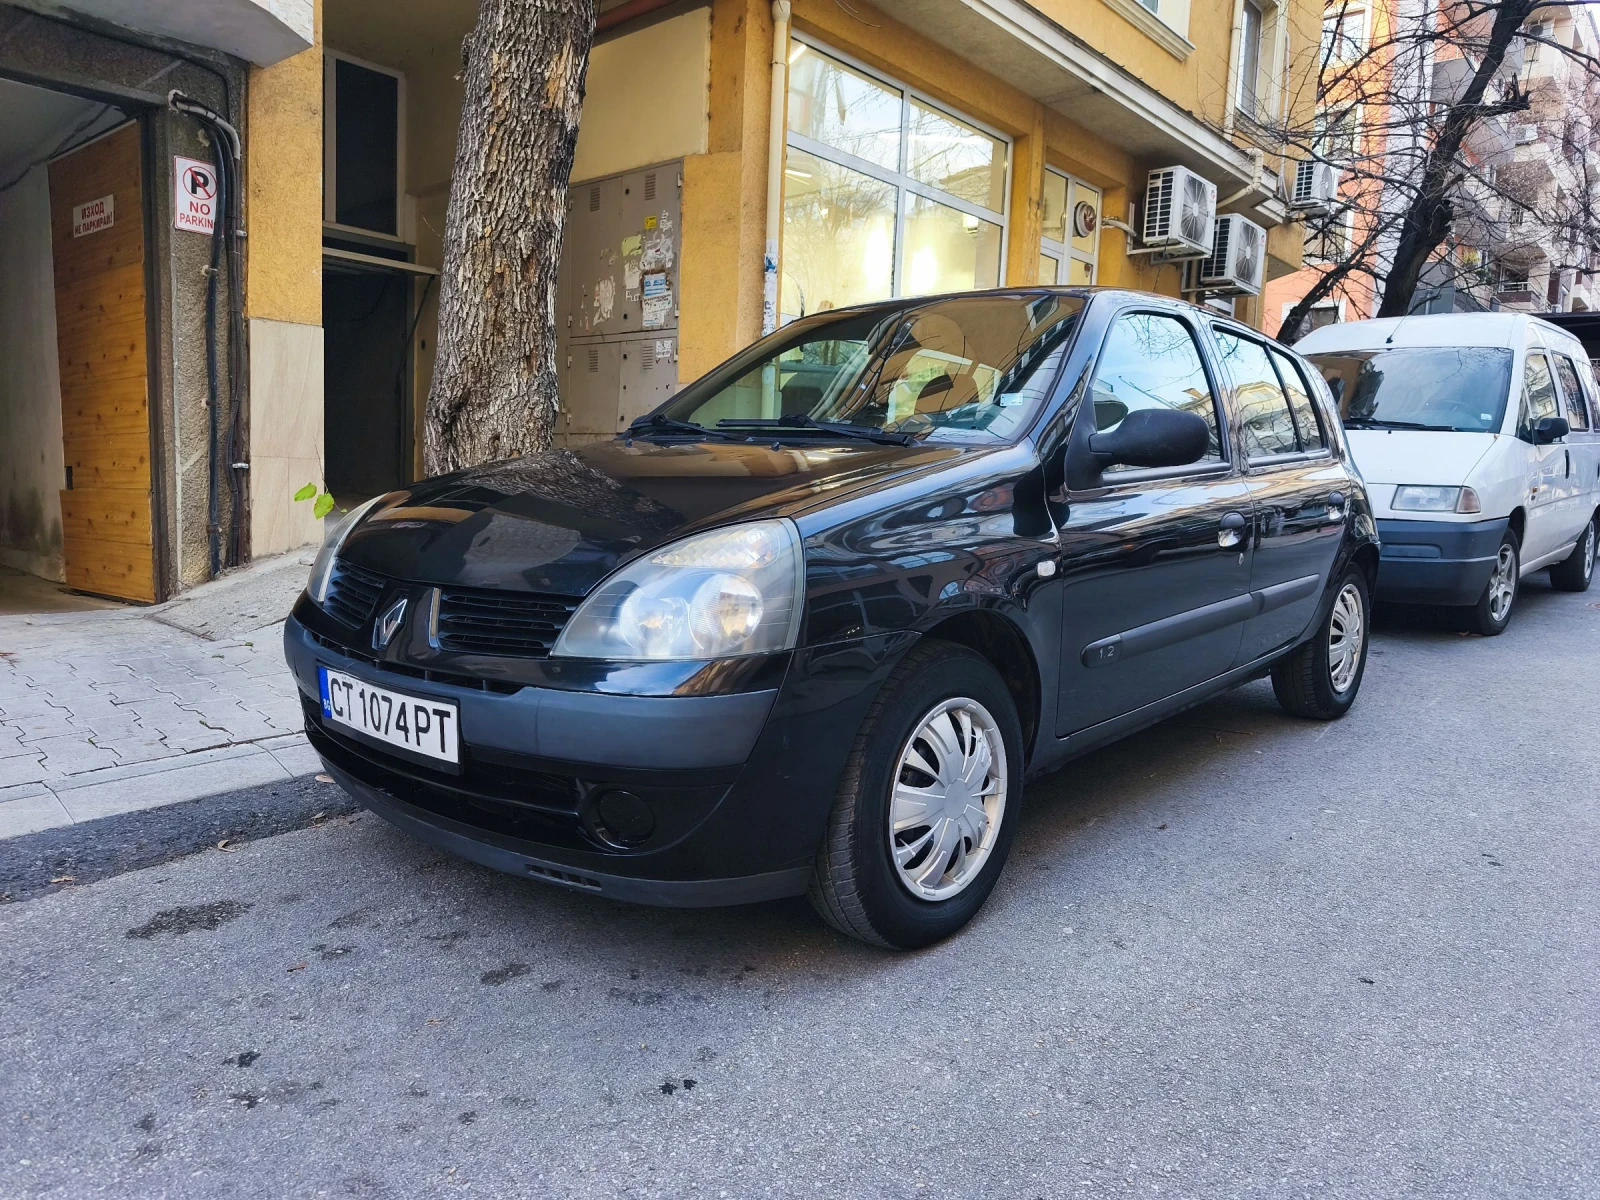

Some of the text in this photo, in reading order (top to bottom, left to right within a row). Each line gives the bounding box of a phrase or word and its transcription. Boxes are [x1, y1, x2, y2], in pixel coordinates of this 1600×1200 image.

[81, 202, 105, 220] ИЗХОД
[190, 201, 211, 215] NO
[180, 213, 214, 229] PARKIN
[75, 225, 82, 235] НЕ
